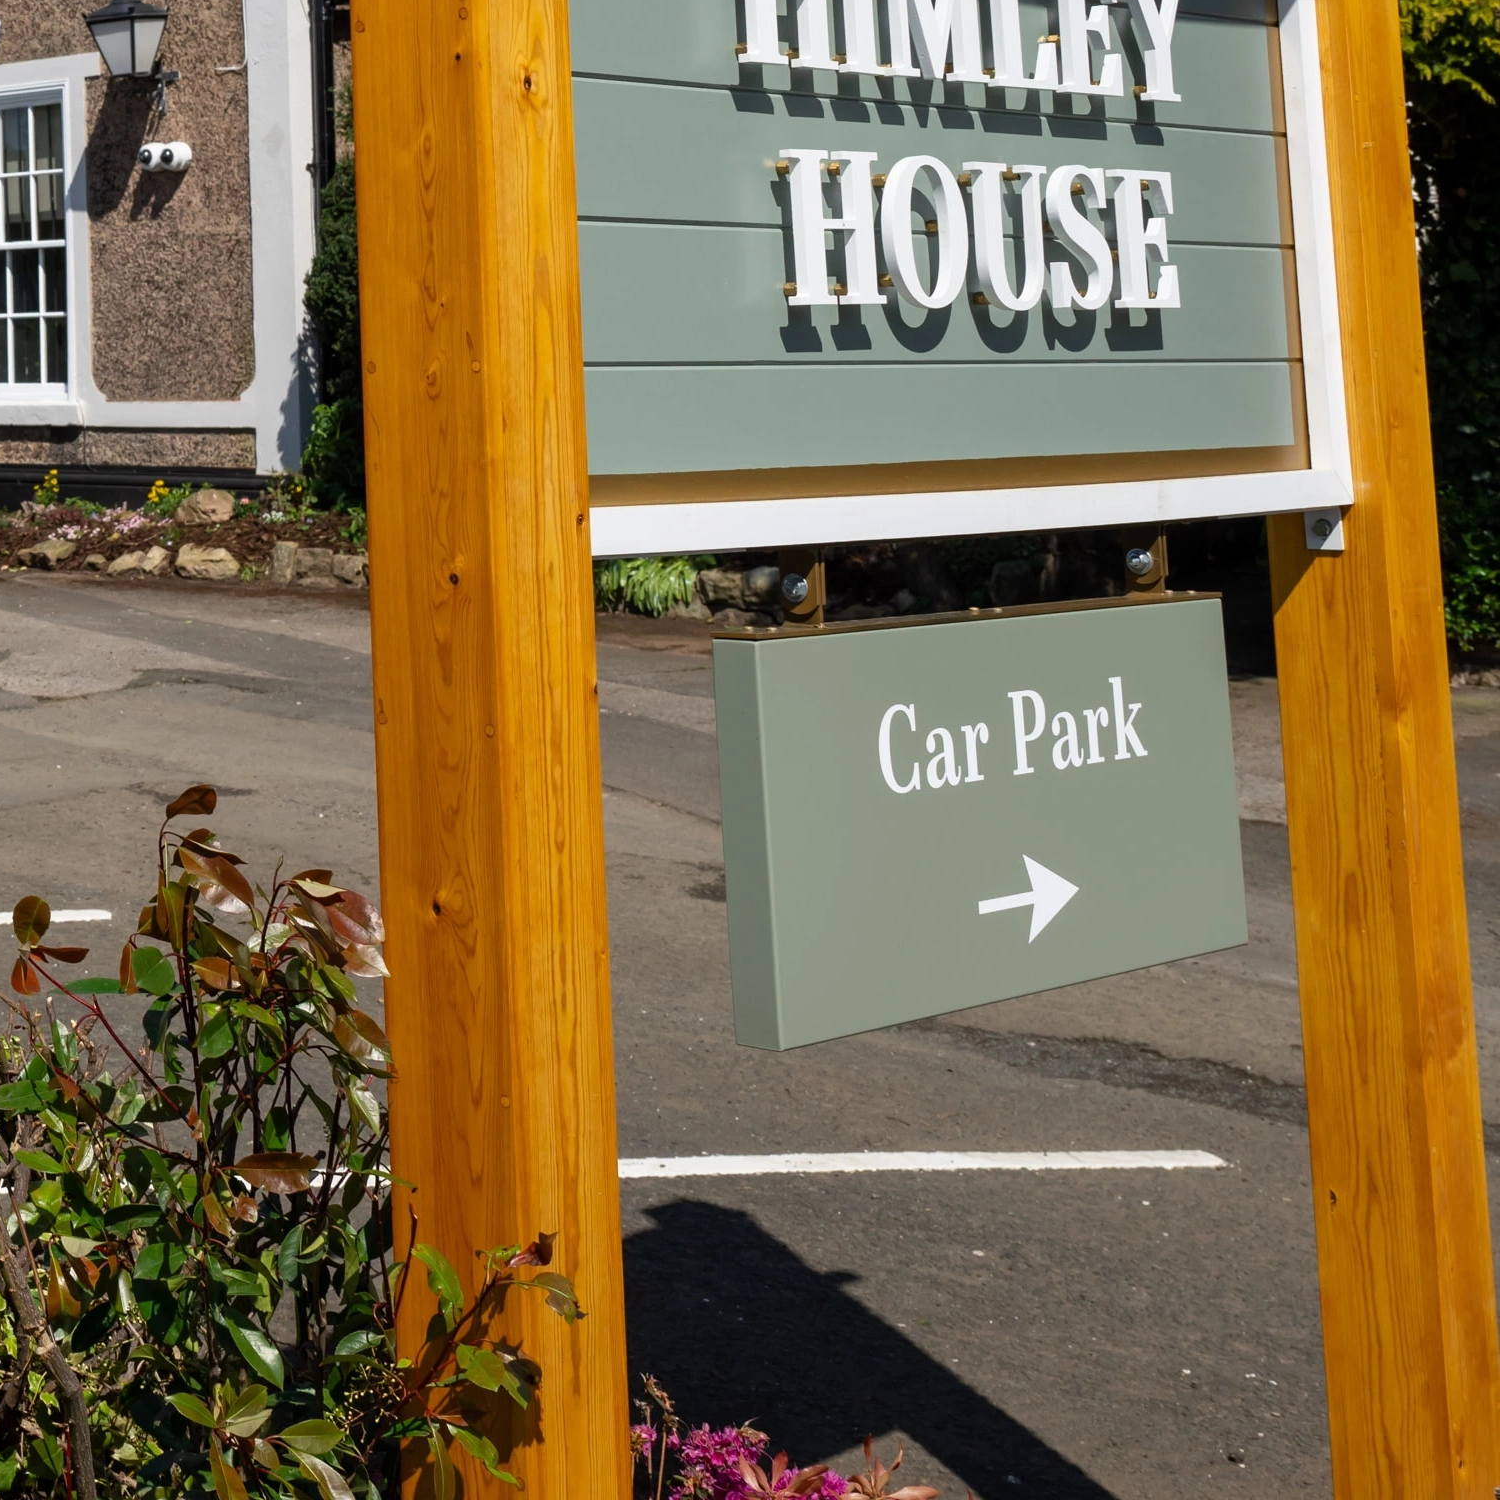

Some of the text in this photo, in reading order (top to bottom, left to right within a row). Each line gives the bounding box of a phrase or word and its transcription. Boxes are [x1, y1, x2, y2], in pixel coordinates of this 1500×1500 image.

[779, 148, 1181, 311] HOUSE
[878, 676, 1148, 794] Car Park
